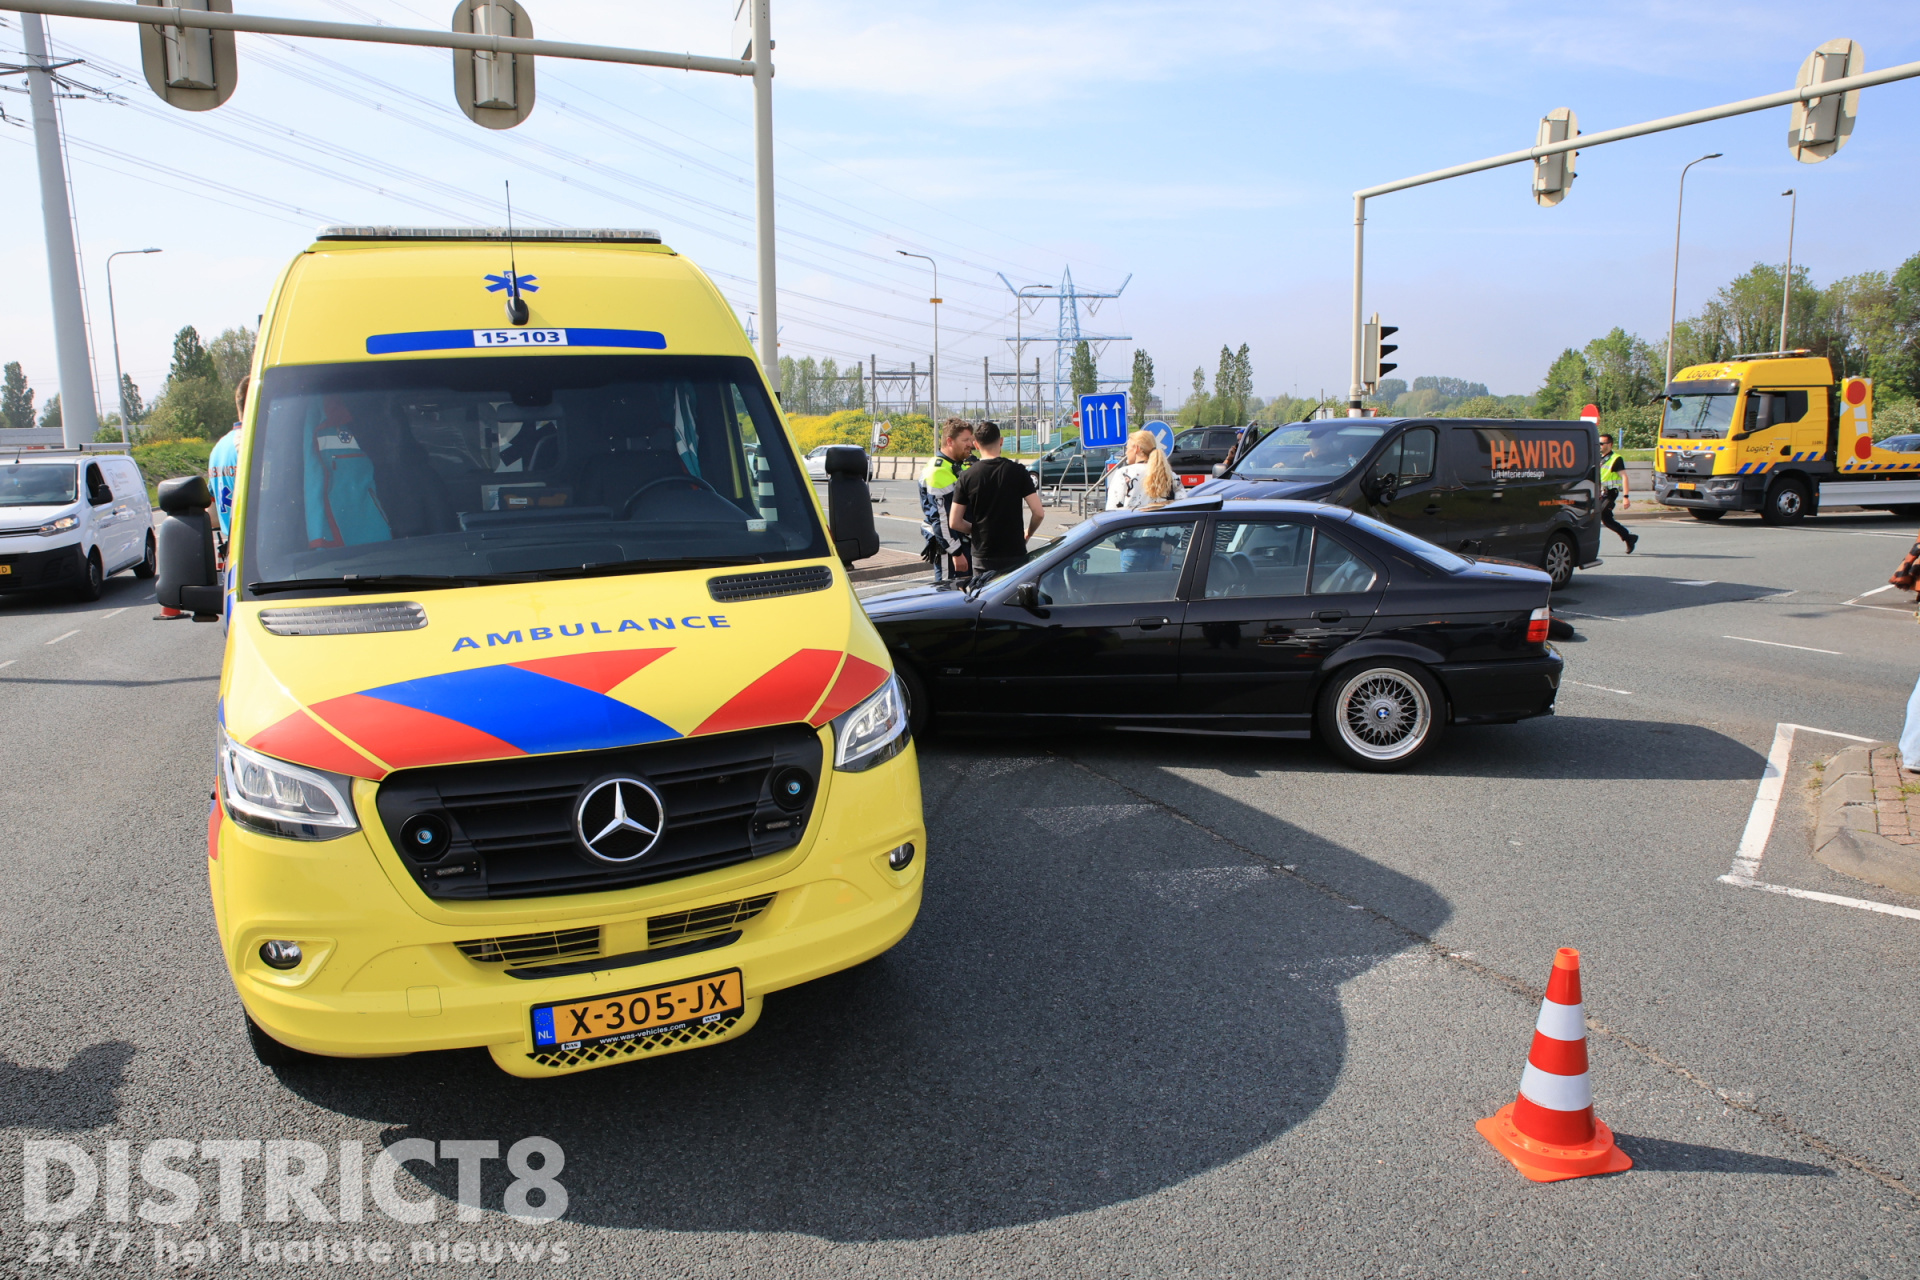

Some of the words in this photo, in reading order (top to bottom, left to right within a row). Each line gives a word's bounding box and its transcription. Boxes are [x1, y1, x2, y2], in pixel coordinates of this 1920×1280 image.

[481, 331, 560, 343] 15-103
[1686, 368, 1720, 380] Logicx
[1490, 440, 1576, 470] HAWIRO
[1746, 445, 1769, 454] Logicx
[451, 615, 731, 653] AMBULANCE
[569, 979, 728, 1037] X-305-JX
[537, 1030, 553, 1040] NL
[599, 1022, 687, 1044] www.was-vehicles.com
